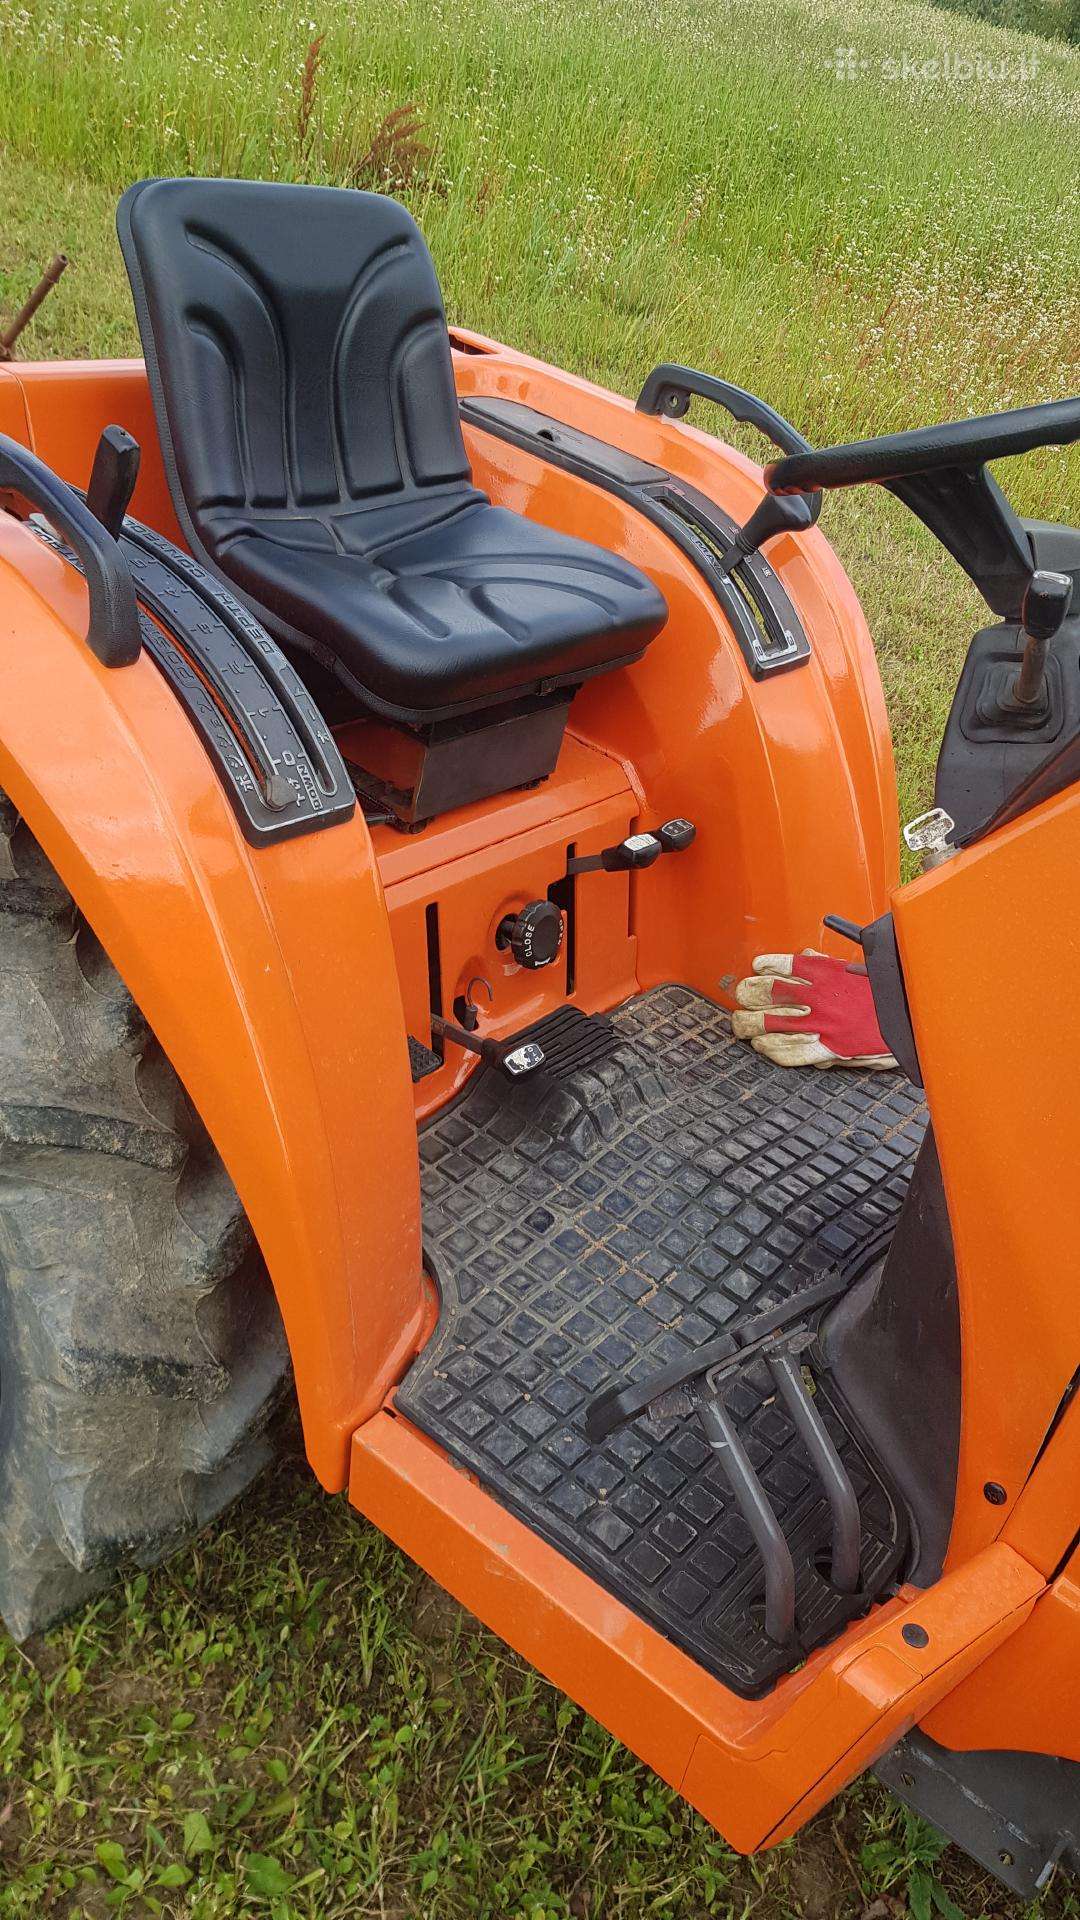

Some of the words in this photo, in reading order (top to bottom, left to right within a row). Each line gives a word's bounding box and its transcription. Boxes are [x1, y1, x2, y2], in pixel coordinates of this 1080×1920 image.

[125, 519, 206, 579] CONTROL
[215, 592, 276, 655] DEPTH
[298, 765, 321, 810] DOWN
[524, 924, 535, 957] CLOSE
